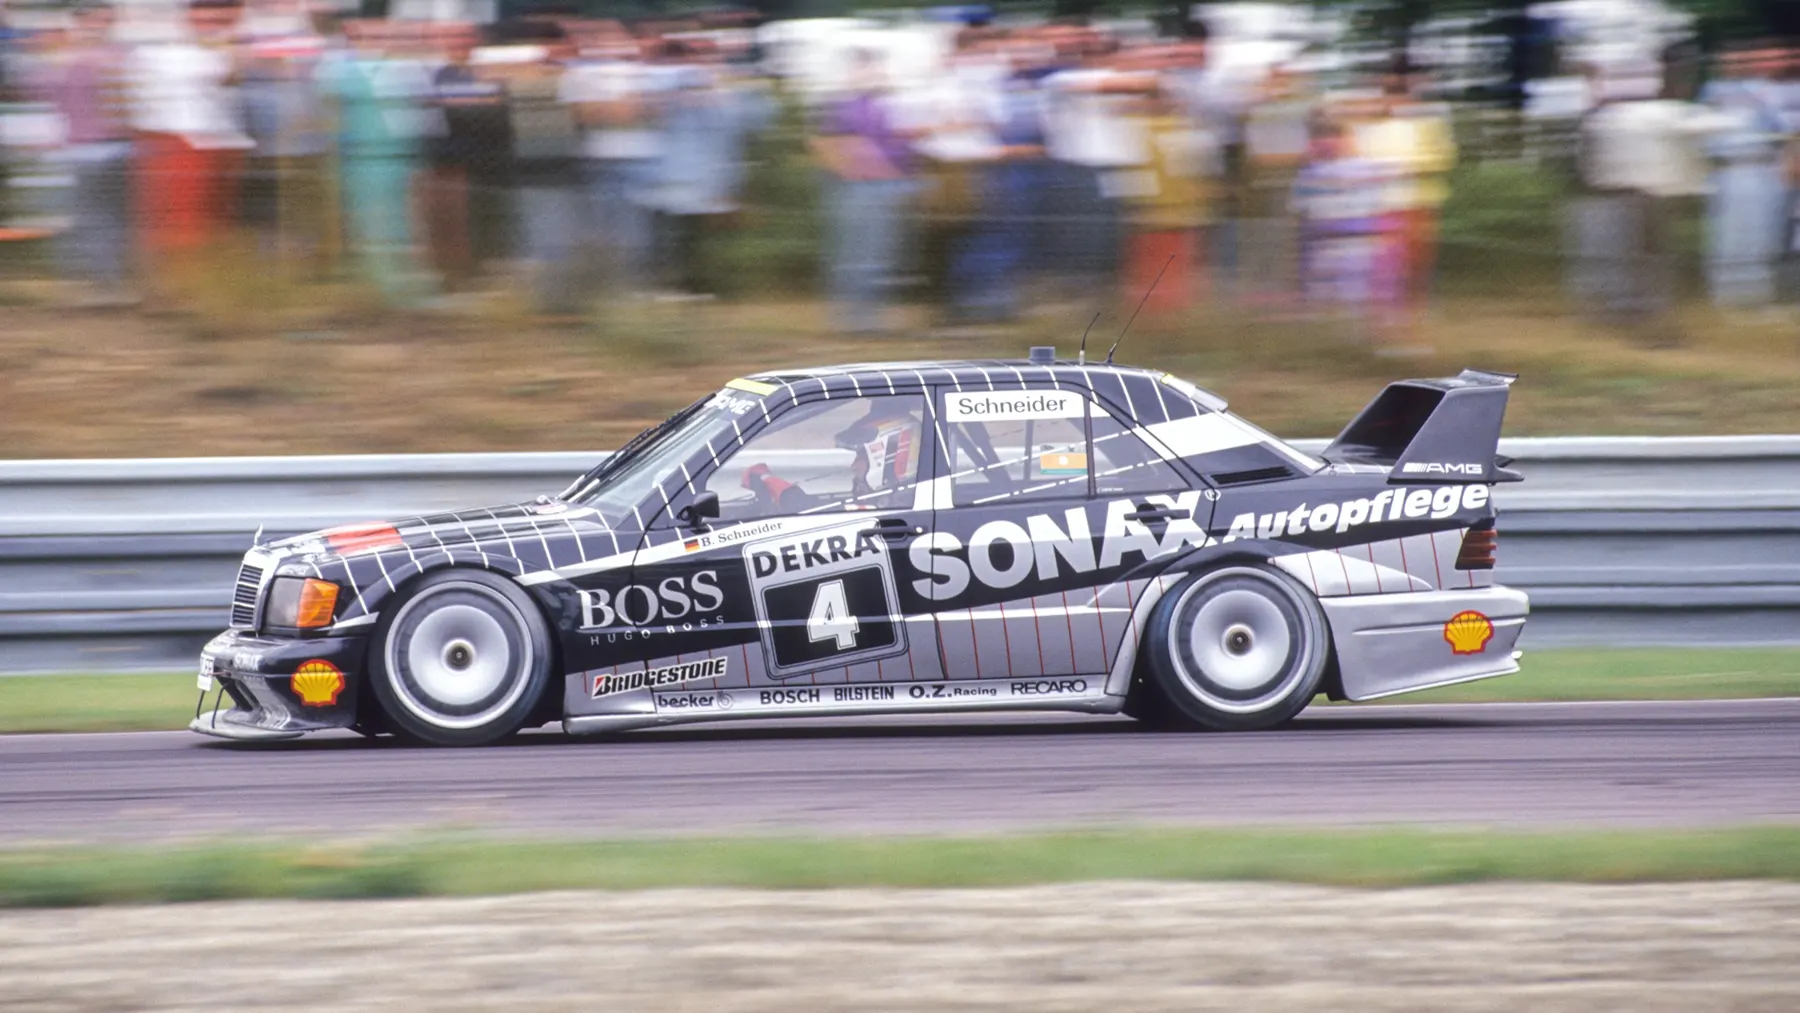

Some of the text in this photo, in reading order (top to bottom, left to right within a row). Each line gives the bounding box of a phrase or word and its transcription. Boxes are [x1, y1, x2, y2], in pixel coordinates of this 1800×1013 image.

[958, 395, 1067, 415] Schneider
[1424, 462, 1483, 475] AMG
[701, 522, 783, 547] B. Schneider
[908, 483, 1490, 601] SONAX Autopflege
[751, 530, 881, 579] DEKRA
[575, 570, 724, 630] BOSS
[806, 578, 861, 651] 4
[590, 615, 725, 646] HUGO BOSS
[593, 658, 726, 697] BRIDGESTONE
[1010, 678, 1088, 696] RECARO
[657, 693, 715, 708] becker
[759, 688, 821, 705] BOSCH
[833, 685, 895, 701] BILSTEIN
